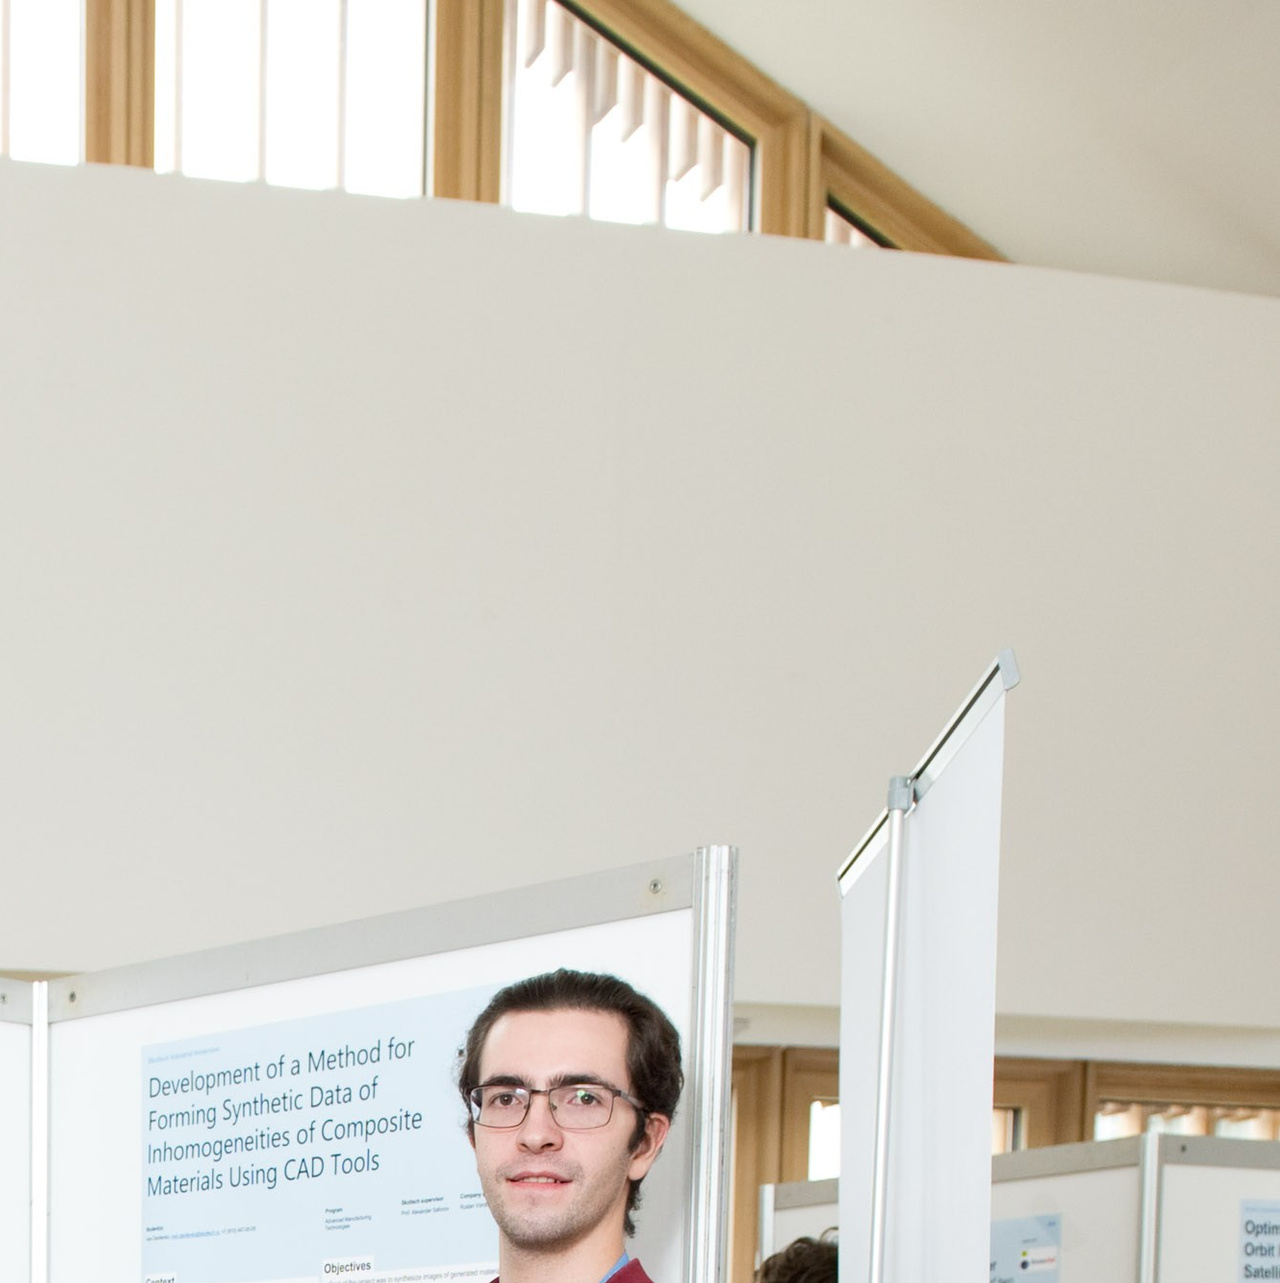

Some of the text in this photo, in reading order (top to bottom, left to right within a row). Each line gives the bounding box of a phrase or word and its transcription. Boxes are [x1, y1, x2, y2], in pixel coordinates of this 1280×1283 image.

[150, 1037, 415, 1098] Development of a Method for
[149, 1075, 378, 1131] Forming Synthetic Data of
[149, 1109, 422, 1164] Inhomogeneities of Composite
[148, 1150, 379, 1196] Materials Using CAD Tools
[324, 1262, 371, 1275] Objectives
[1244, 1242, 1275, 1257] Orbit
